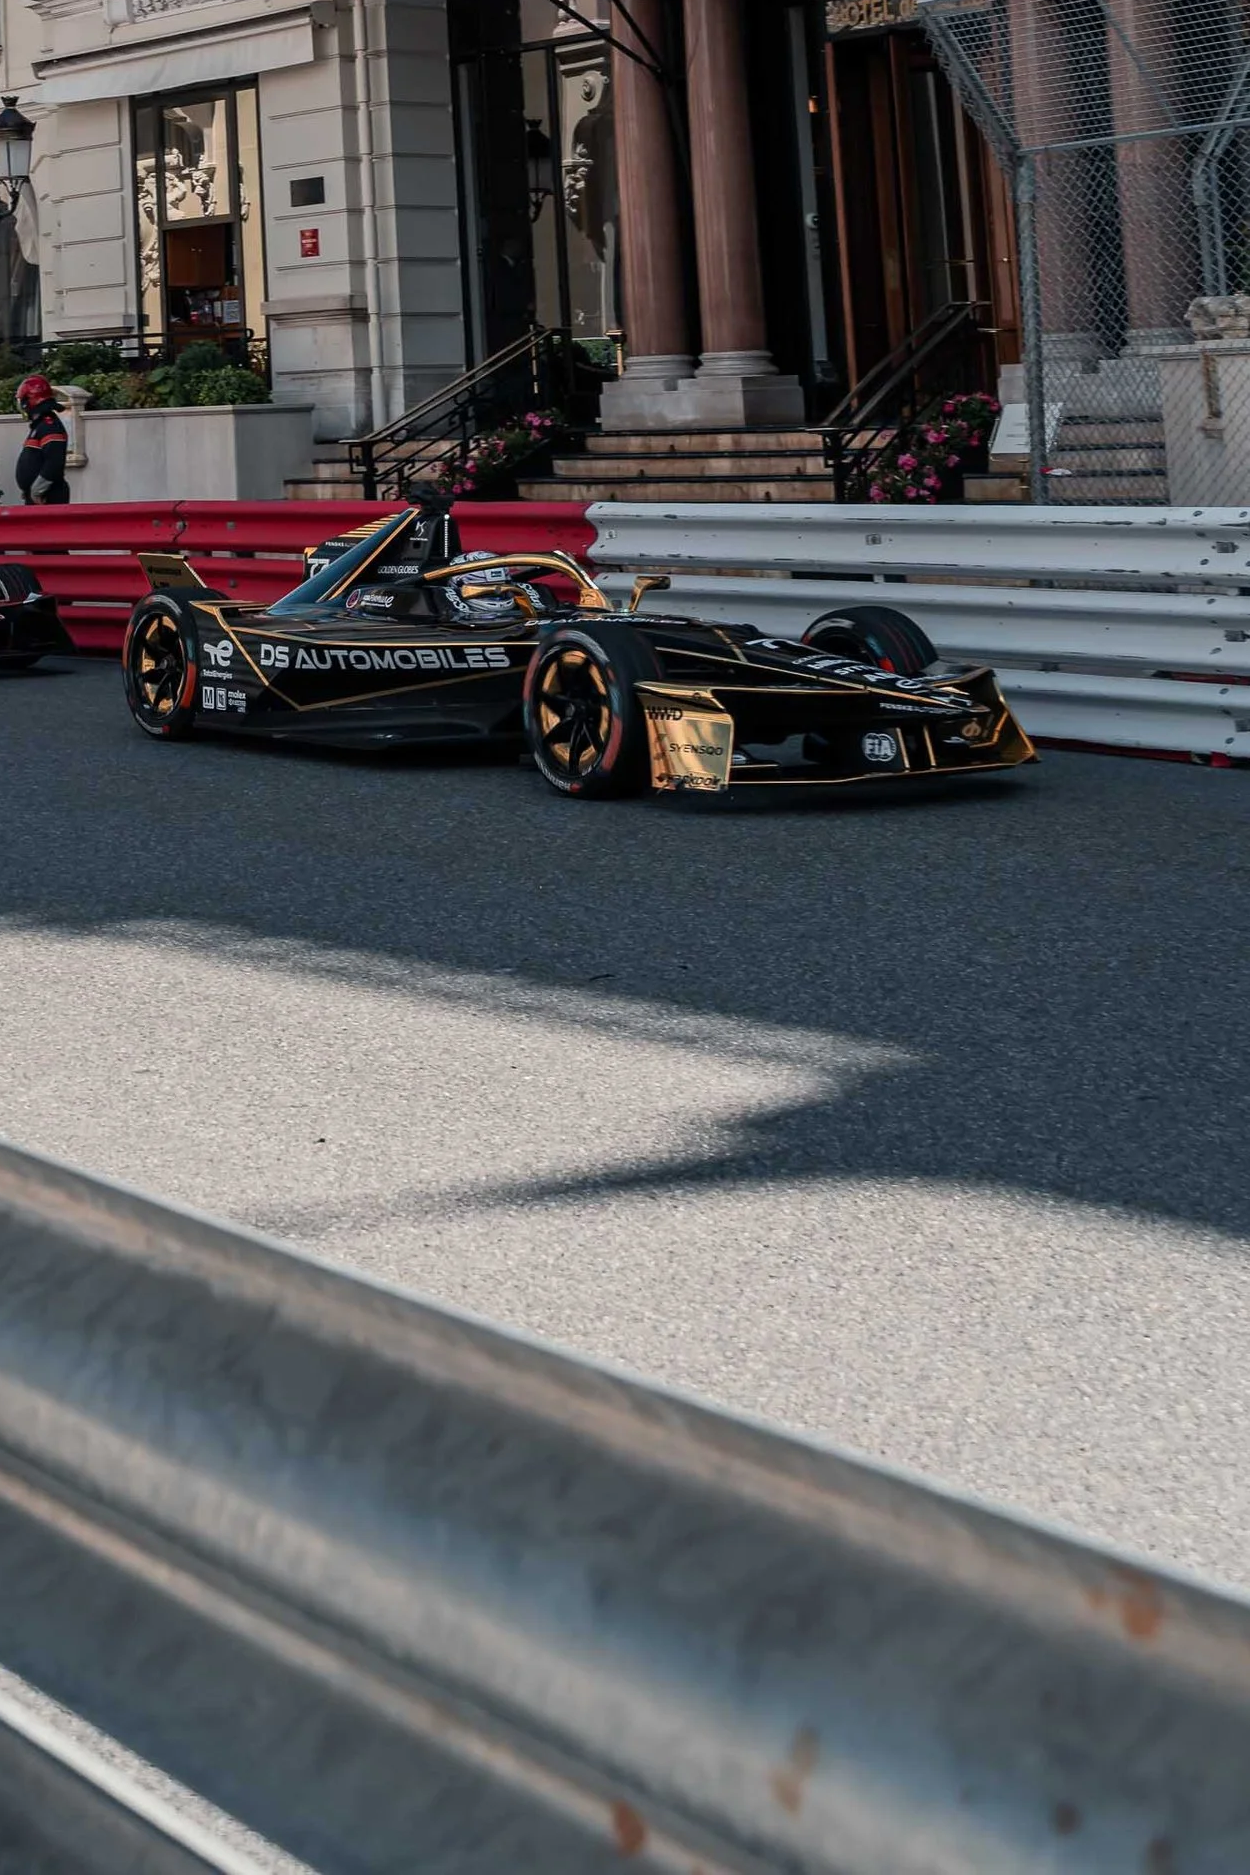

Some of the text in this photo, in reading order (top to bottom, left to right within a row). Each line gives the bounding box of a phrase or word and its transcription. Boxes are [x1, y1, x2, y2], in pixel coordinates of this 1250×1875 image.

[260, 643, 510, 670] DS AUTOMOBILES
[670, 743, 724, 756] SYENSQO
[864, 736, 894, 758] FIA
